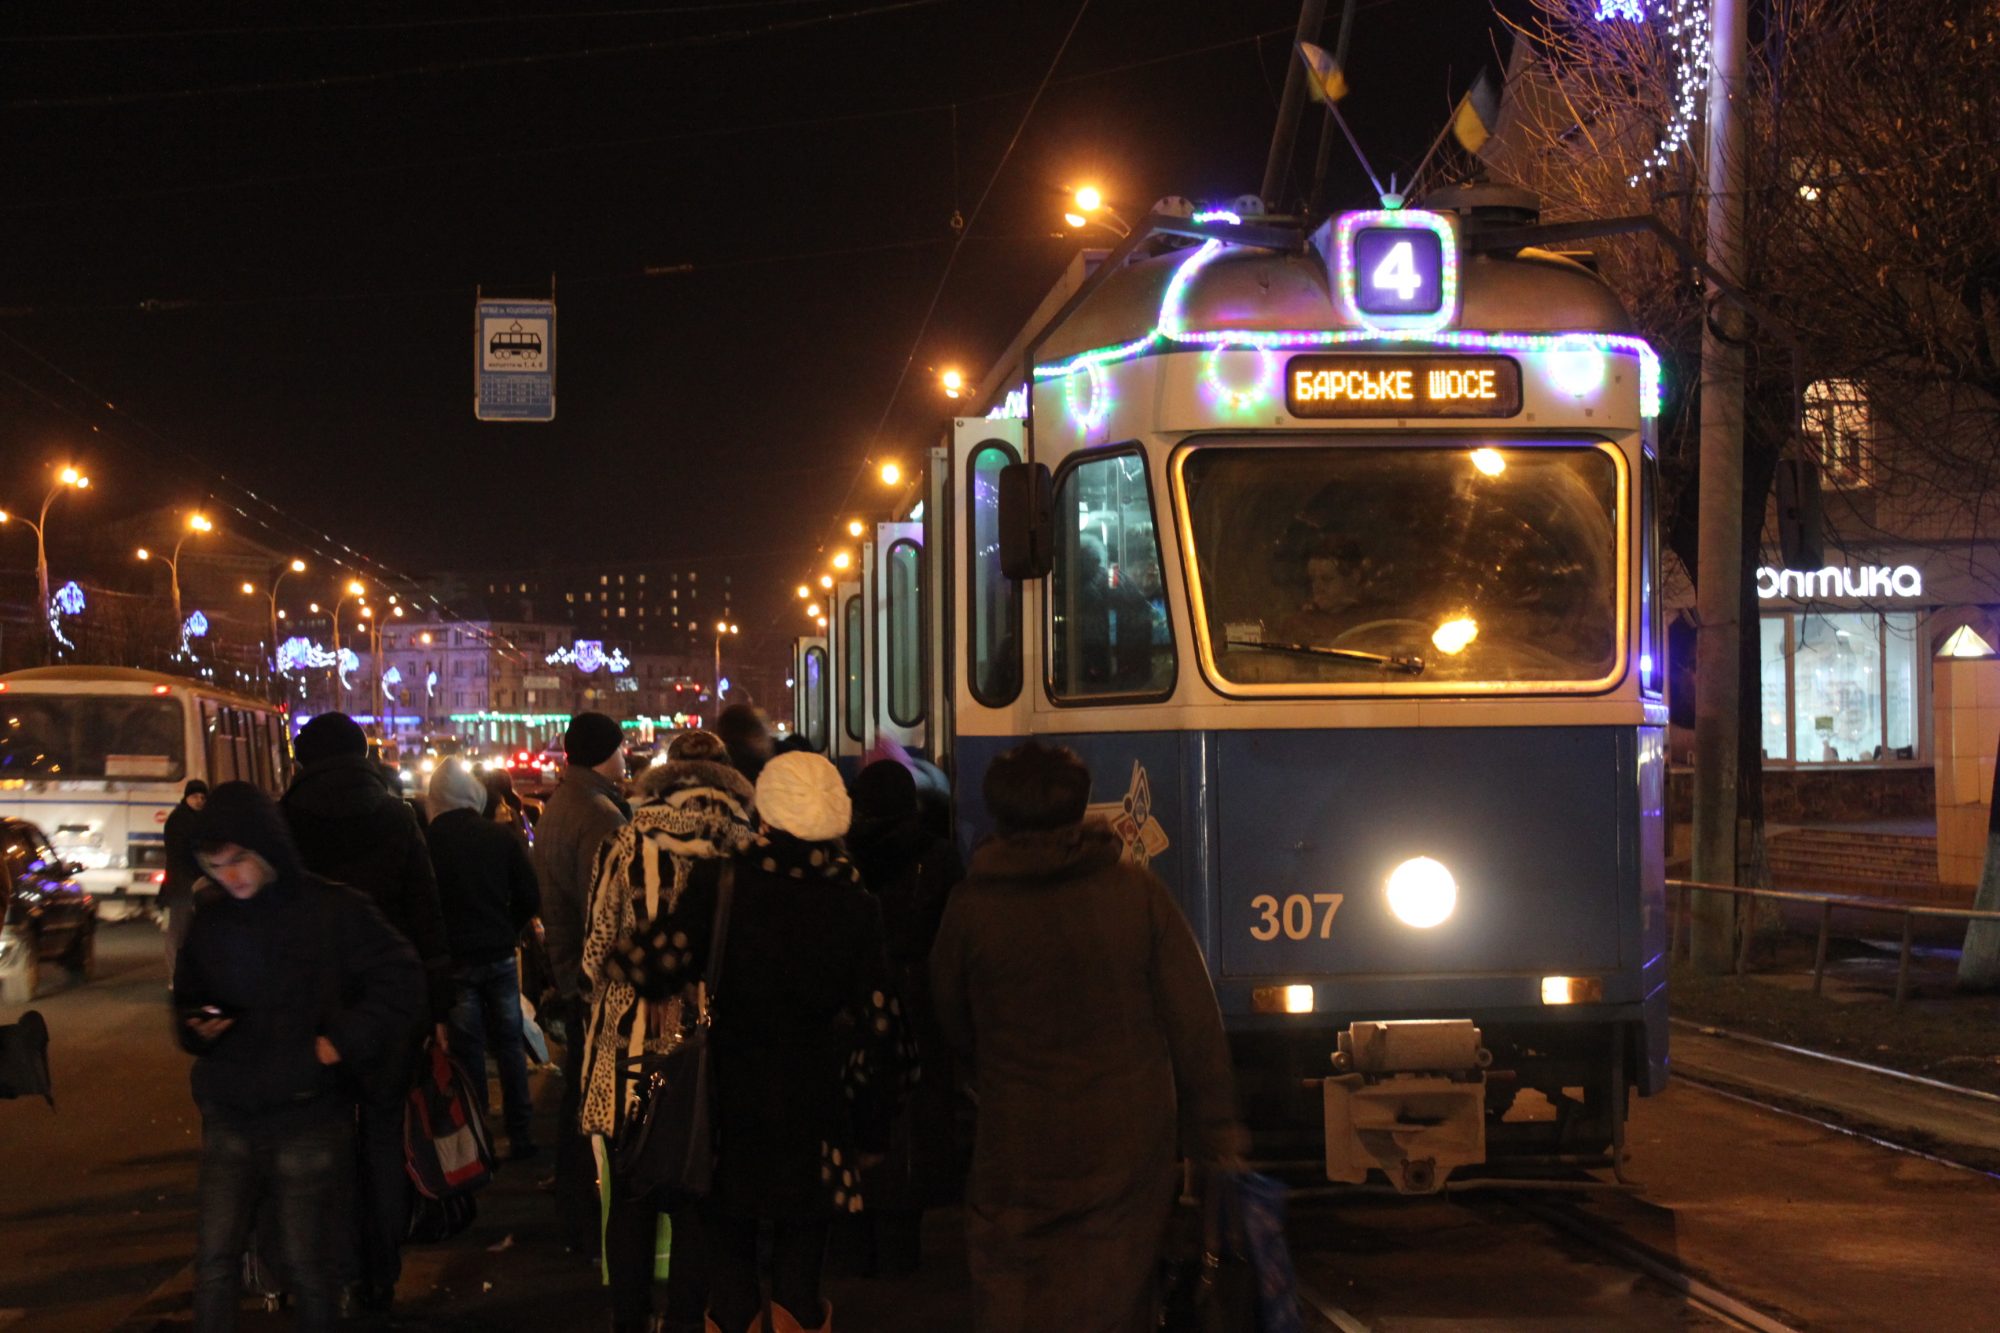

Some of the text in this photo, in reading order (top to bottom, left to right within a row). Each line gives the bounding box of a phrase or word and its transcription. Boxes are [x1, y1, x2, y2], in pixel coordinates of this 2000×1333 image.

[1372, 241, 1422, 300] 4
[1294, 369, 1497, 401] БАРСЬКЕ ШОСЕ
[1249, 893, 1344, 941] 307
